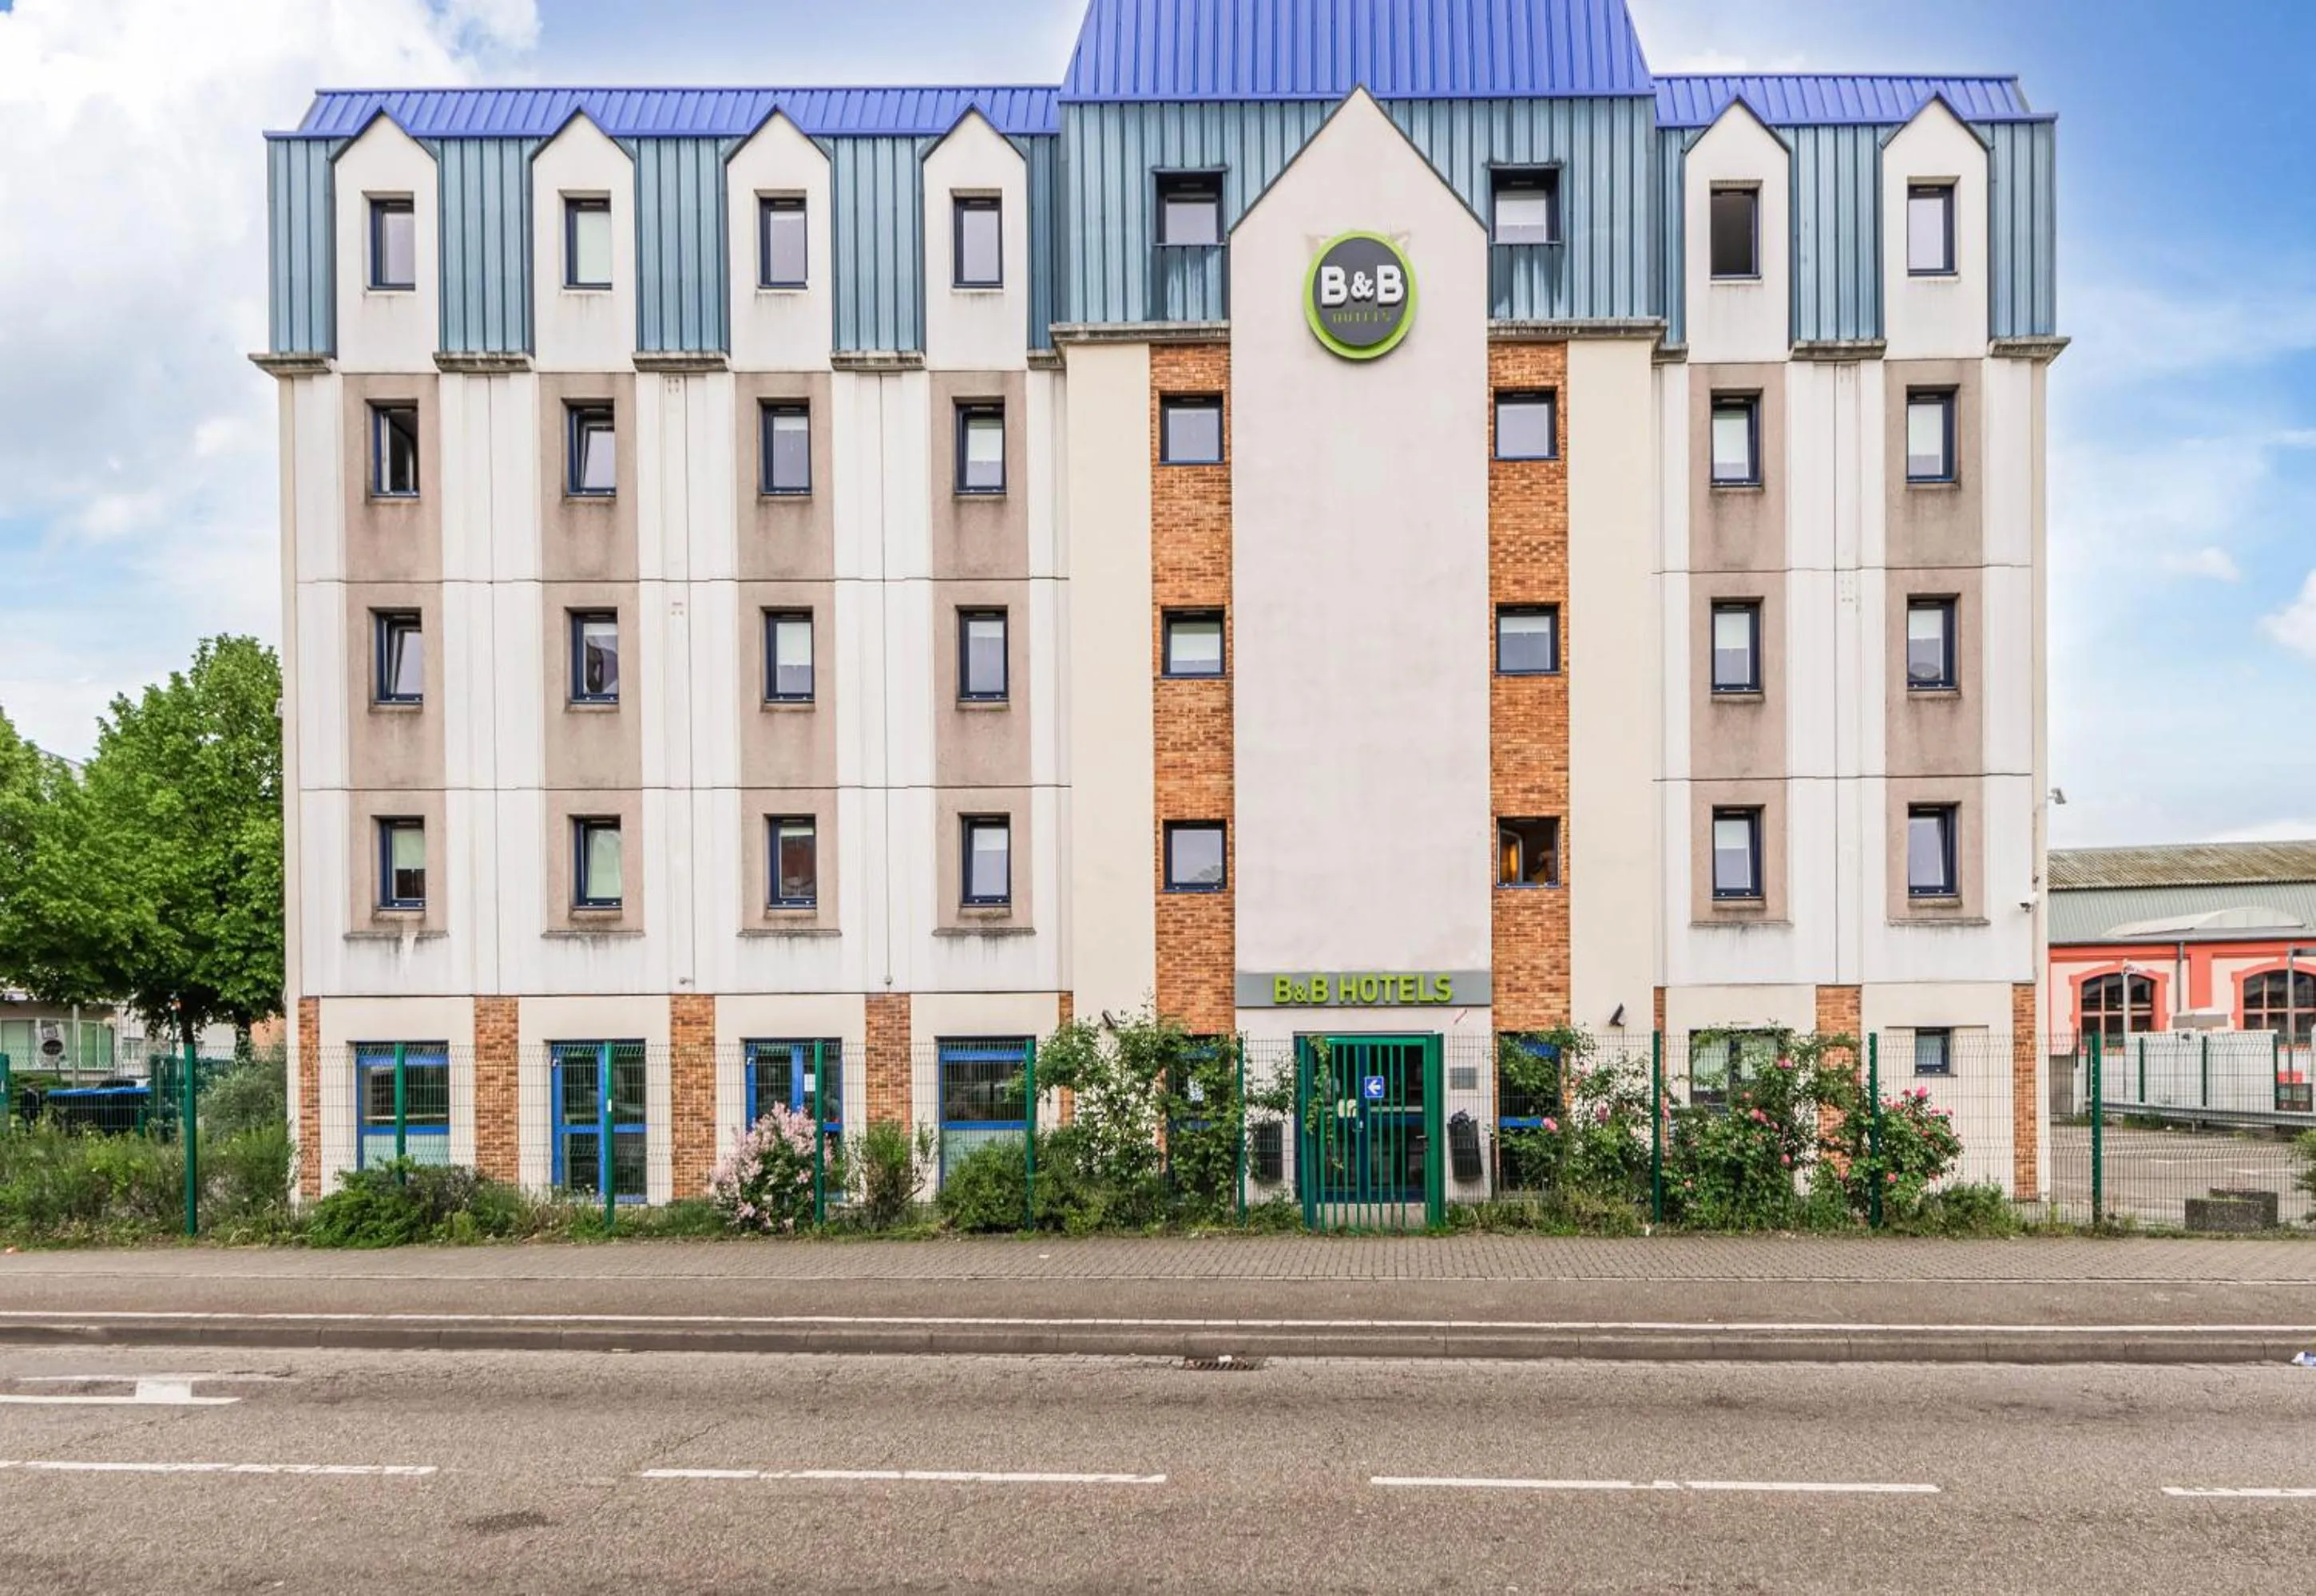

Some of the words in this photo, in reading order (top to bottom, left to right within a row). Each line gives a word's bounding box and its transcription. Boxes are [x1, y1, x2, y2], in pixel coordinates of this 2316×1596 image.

[1321, 264, 1404, 304] B&B
[1275, 975, 1329, 1004] B&B
[1338, 973, 1453, 1004] HOTELS
